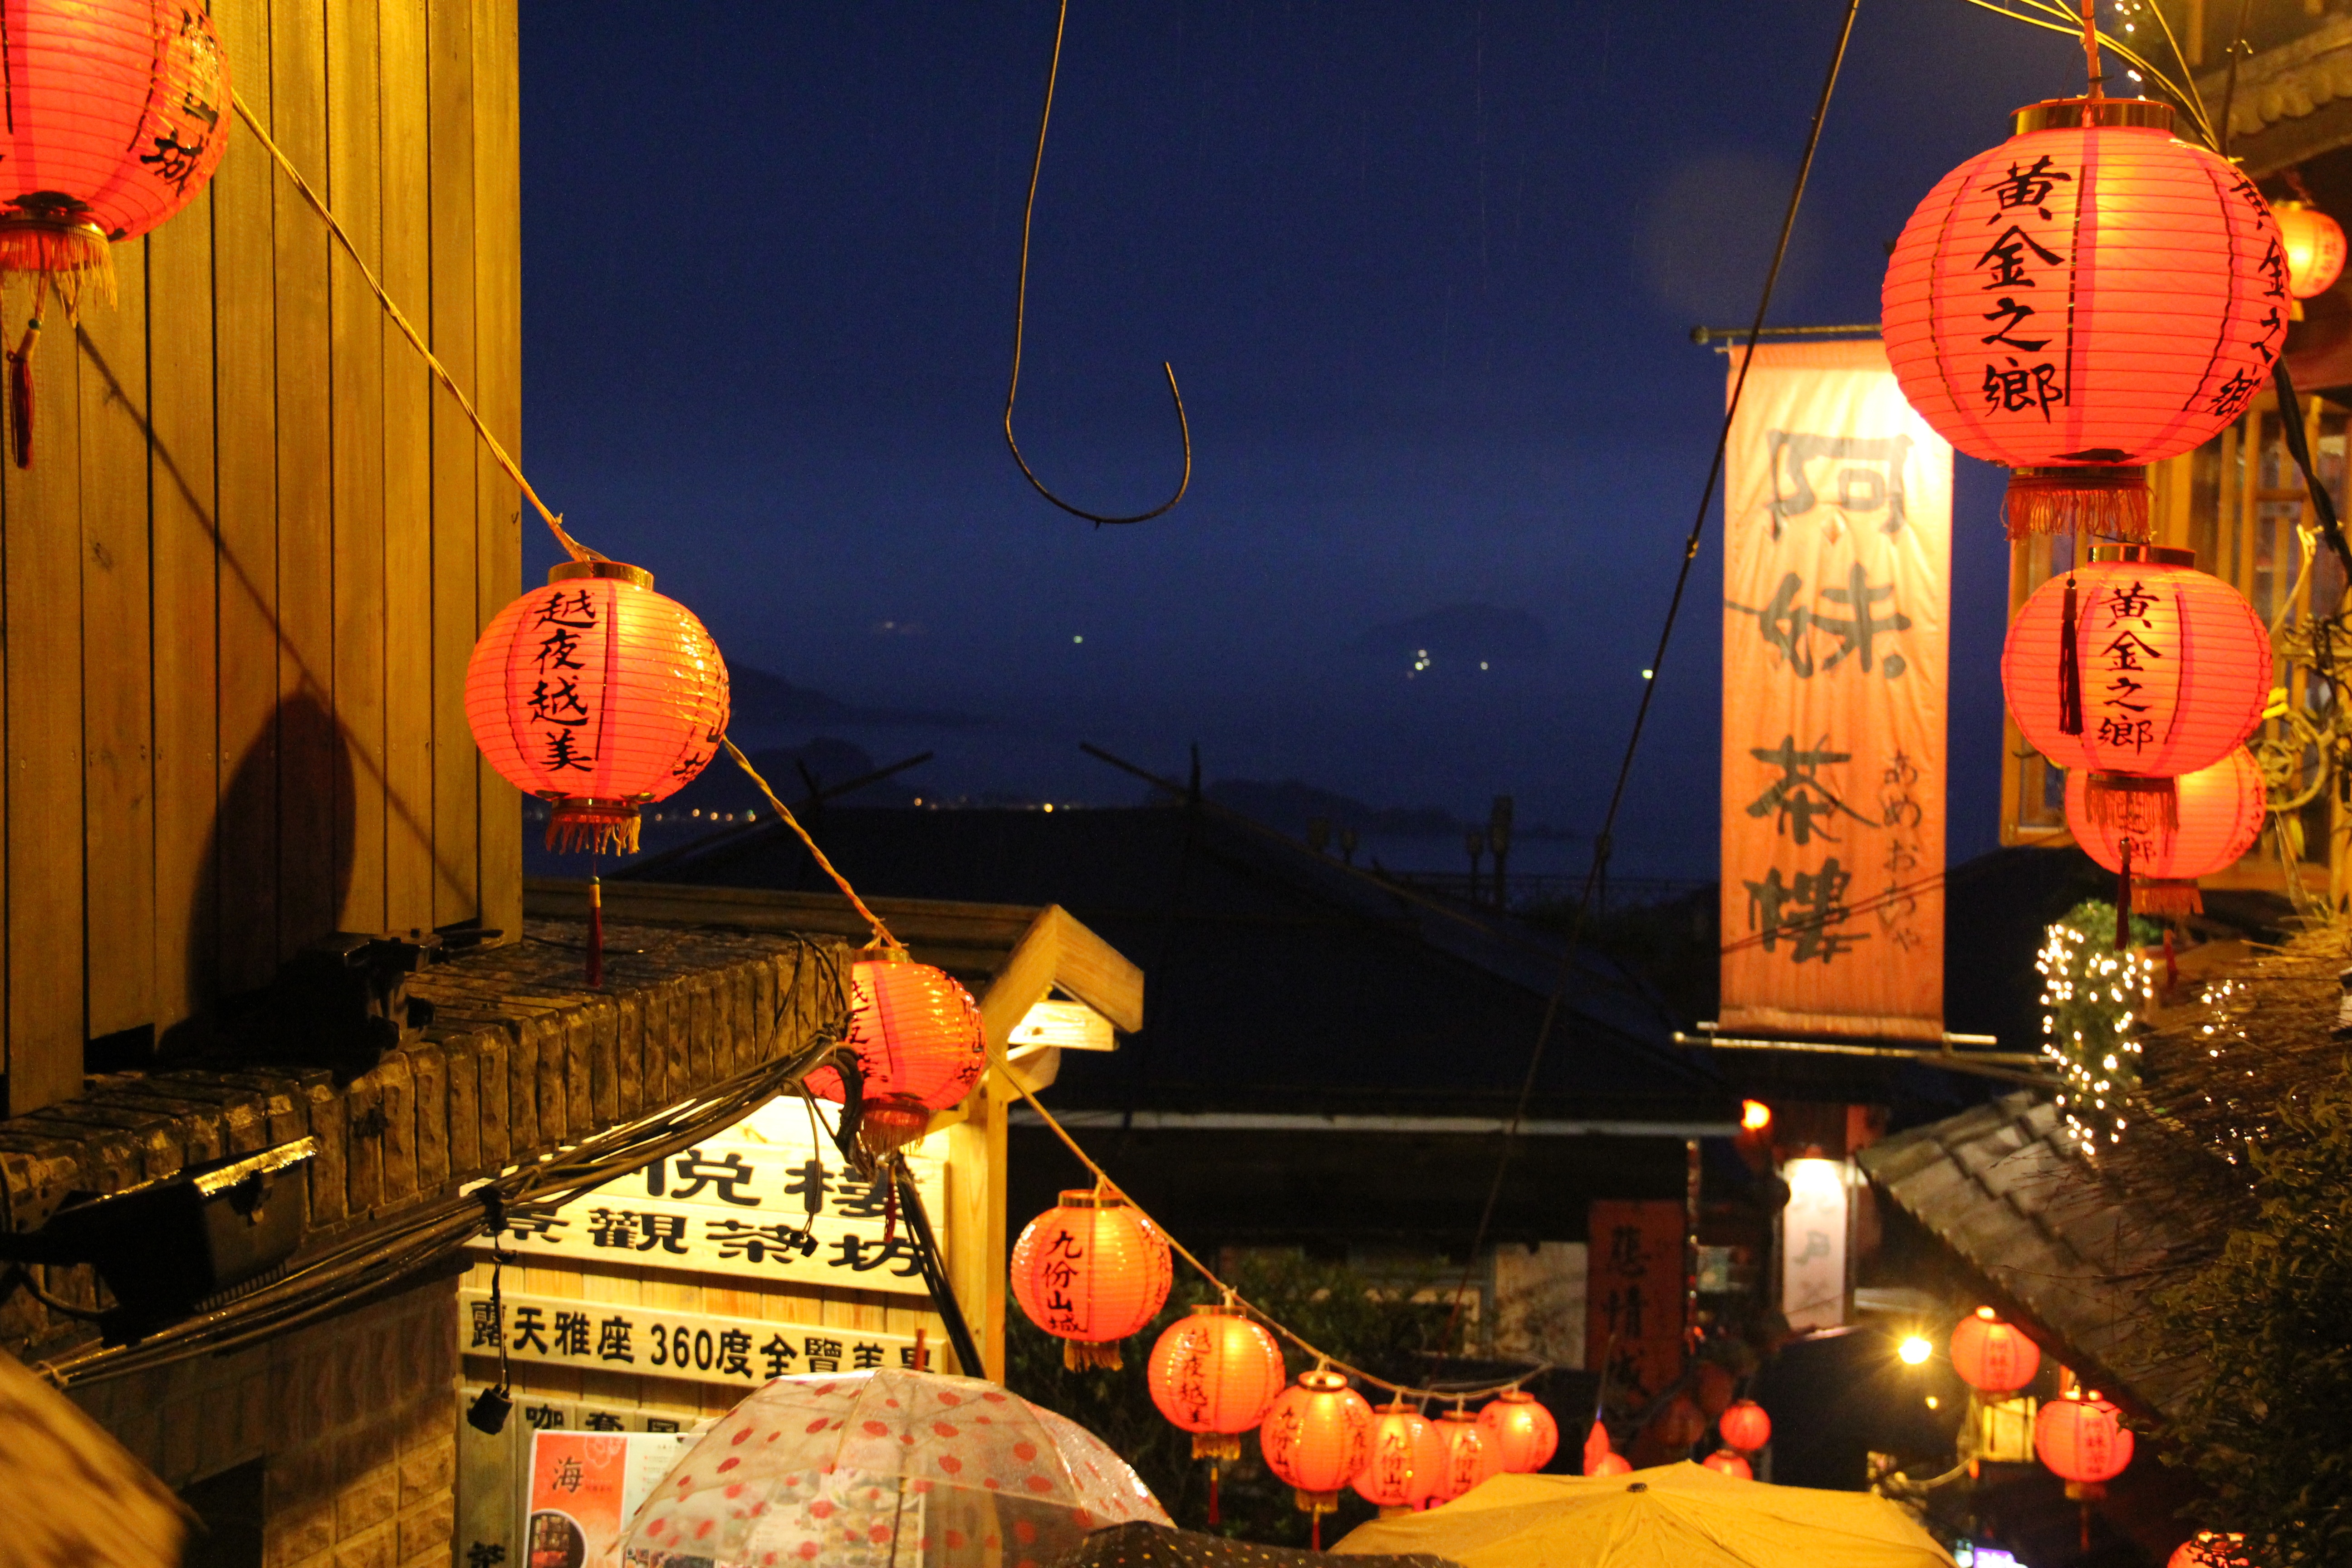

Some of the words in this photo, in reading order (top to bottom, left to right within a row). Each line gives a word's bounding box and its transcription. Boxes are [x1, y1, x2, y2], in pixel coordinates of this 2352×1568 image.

[526, 589, 600, 773] 越夜越美
[1044, 1230, 1088, 1333] 九份山城
